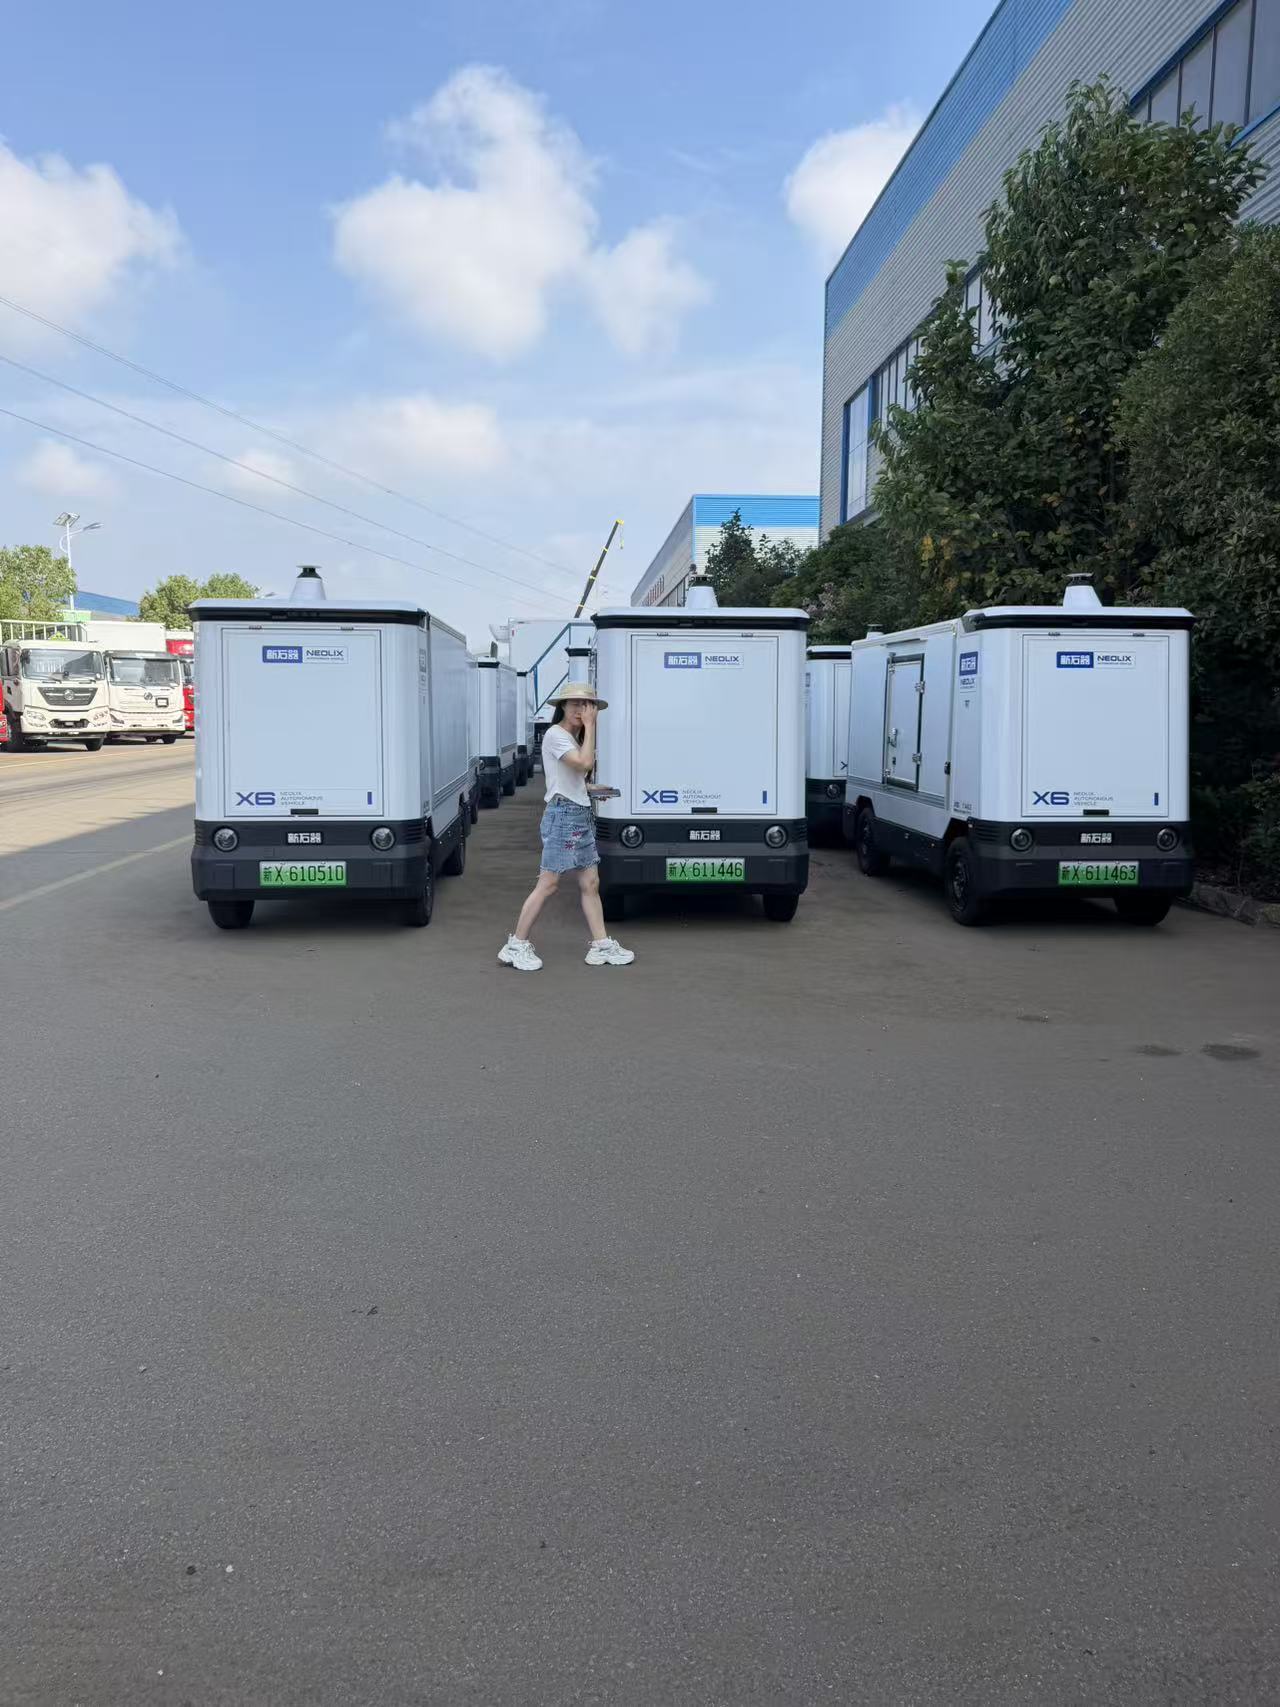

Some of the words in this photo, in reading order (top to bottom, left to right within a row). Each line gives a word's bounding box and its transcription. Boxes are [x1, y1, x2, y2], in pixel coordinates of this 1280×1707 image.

[266, 649, 299, 660] 新石器
[668, 655, 698, 665] 新石器
[1060, 654, 1090, 665] 新石器
[235, 792, 276, 806] X6
[642, 790, 679, 804] X6
[1032, 791, 1070, 805] X6
[287, 832, 322, 843] 新石器
[689, 830, 721, 841] 新石器
[1080, 832, 1112, 844] 新石器
